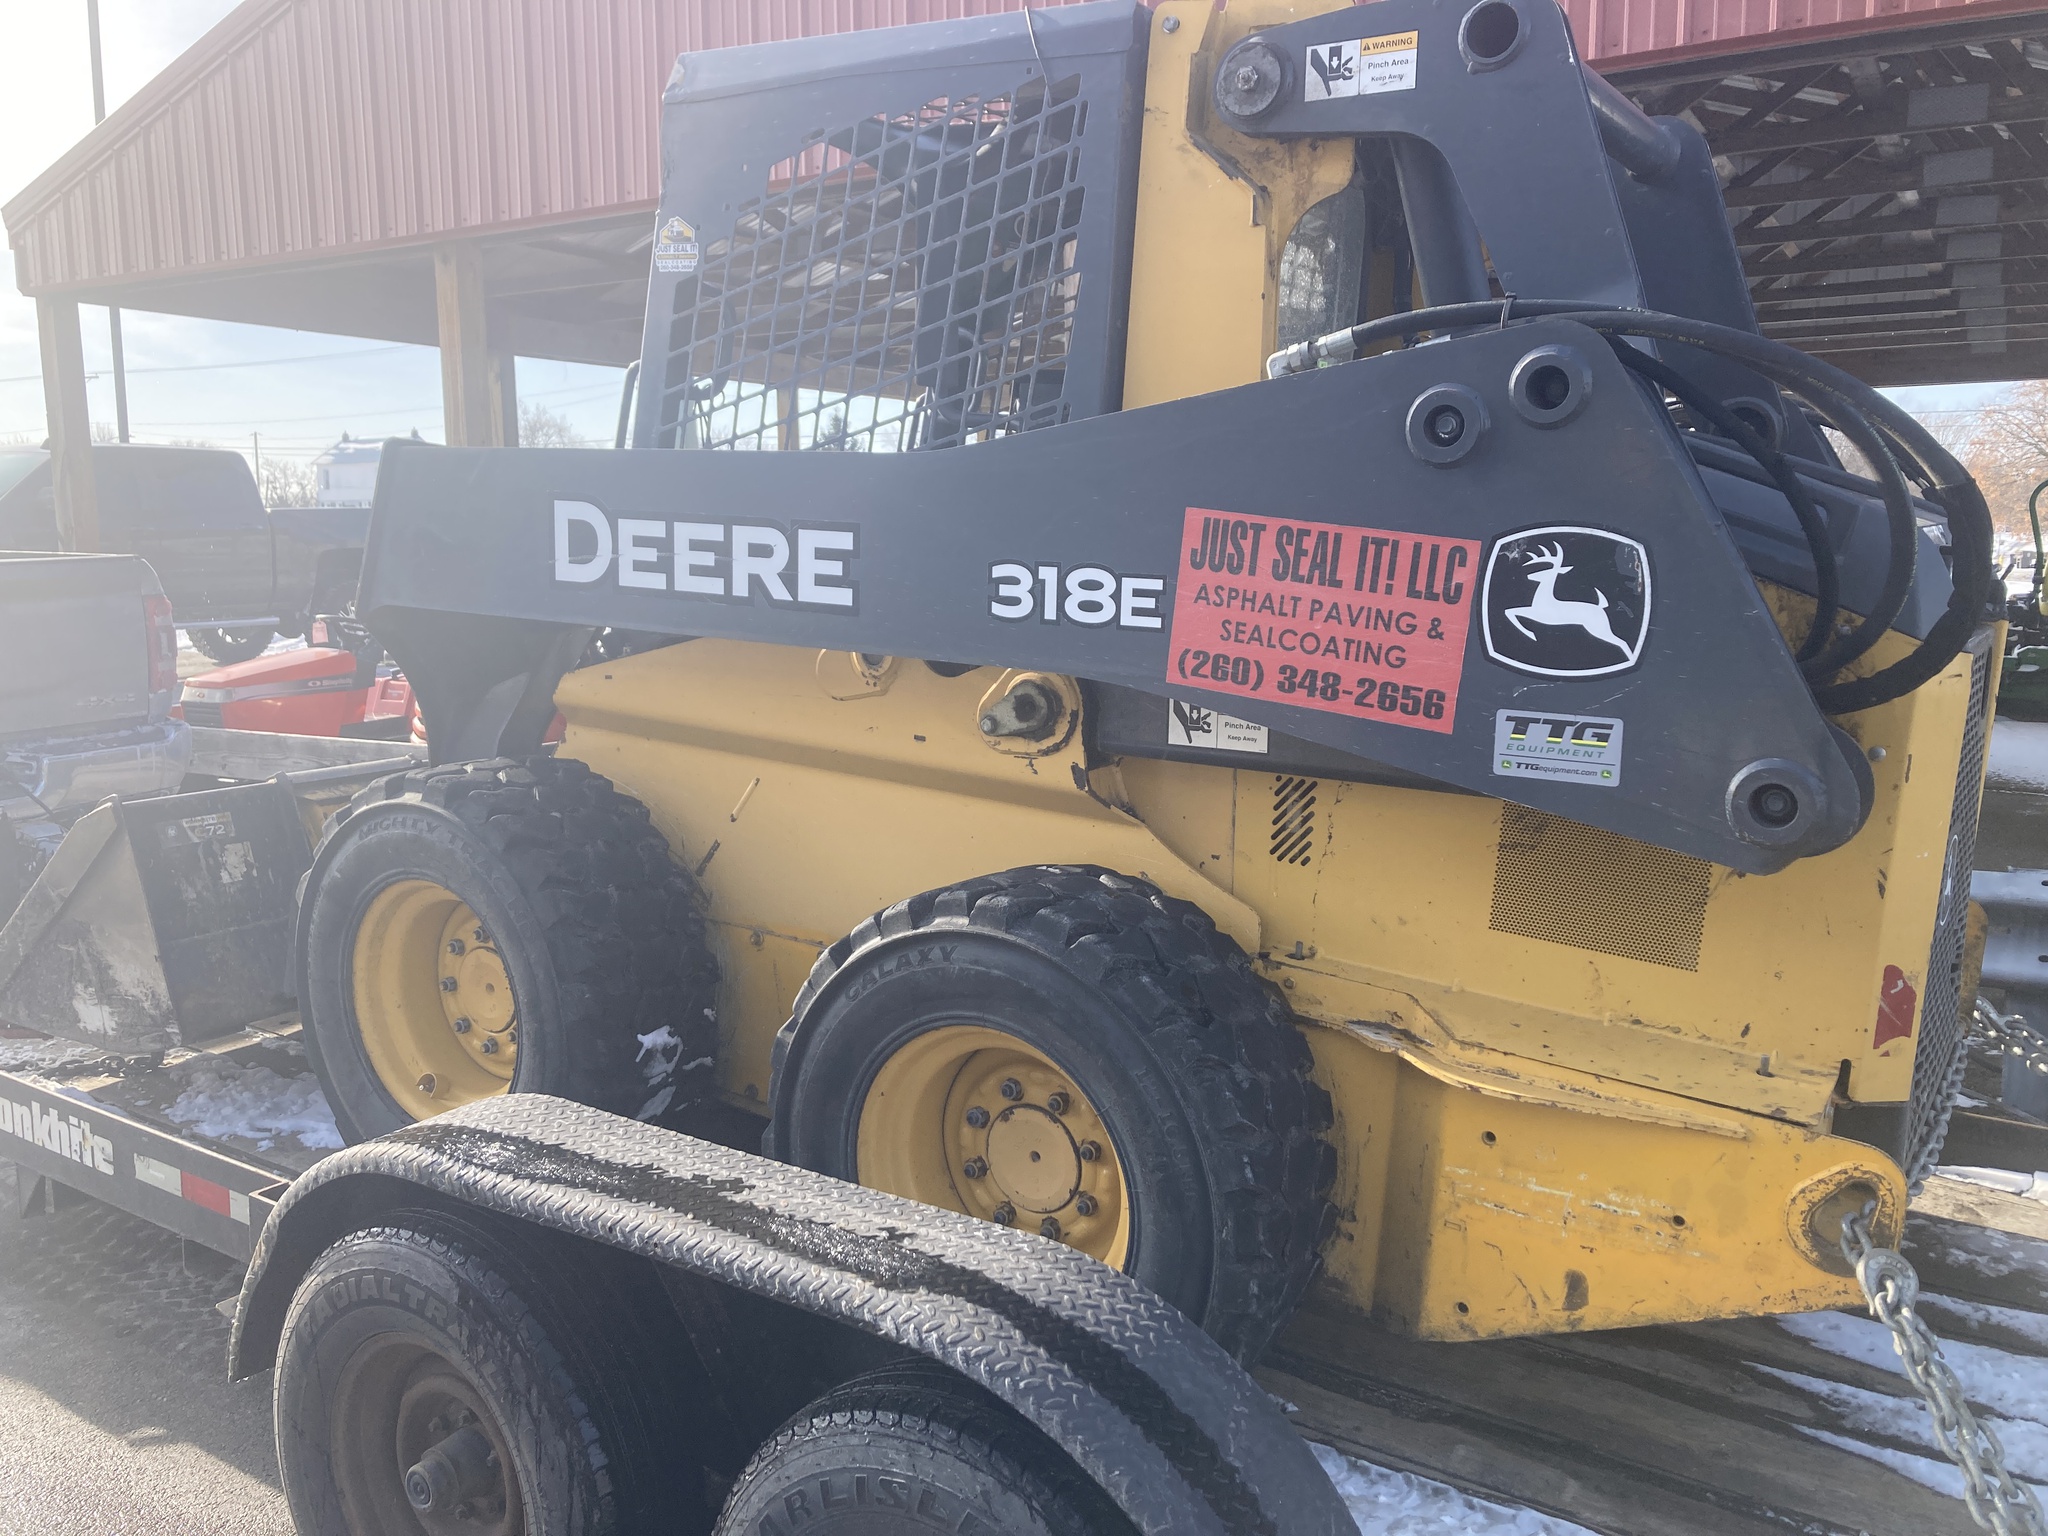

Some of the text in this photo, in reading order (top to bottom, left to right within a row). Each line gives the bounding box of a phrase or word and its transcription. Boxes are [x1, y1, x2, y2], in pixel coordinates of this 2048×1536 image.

[1372, 37, 1413, 50] WARNING
[1367, 58, 1409, 69] Pinch Area
[656, 244, 671, 253] JUST
[672, 244, 689, 253] SEAL
[554, 499, 854, 607] DEERE
[1190, 516, 1468, 605] JUST SEAL IT! LLC
[991, 563, 1164, 629] 318E
[1193, 583, 1445, 641] ASPHALT PAVING &
[1219, 619, 1407, 669] SEALCOATING
[1178, 648, 1446, 720] (260) 348-2656
[1224, 721, 1262, 731] Pinch Area
[1505, 715, 1614, 748] TTG
[1506, 743, 1605, 759] EQUIPMENT
[1515, 762, 1598, 777] TTGequipment.com
[358, 814, 442, 841] MIGHTY
[844, 945, 959, 1003] GALAXY
